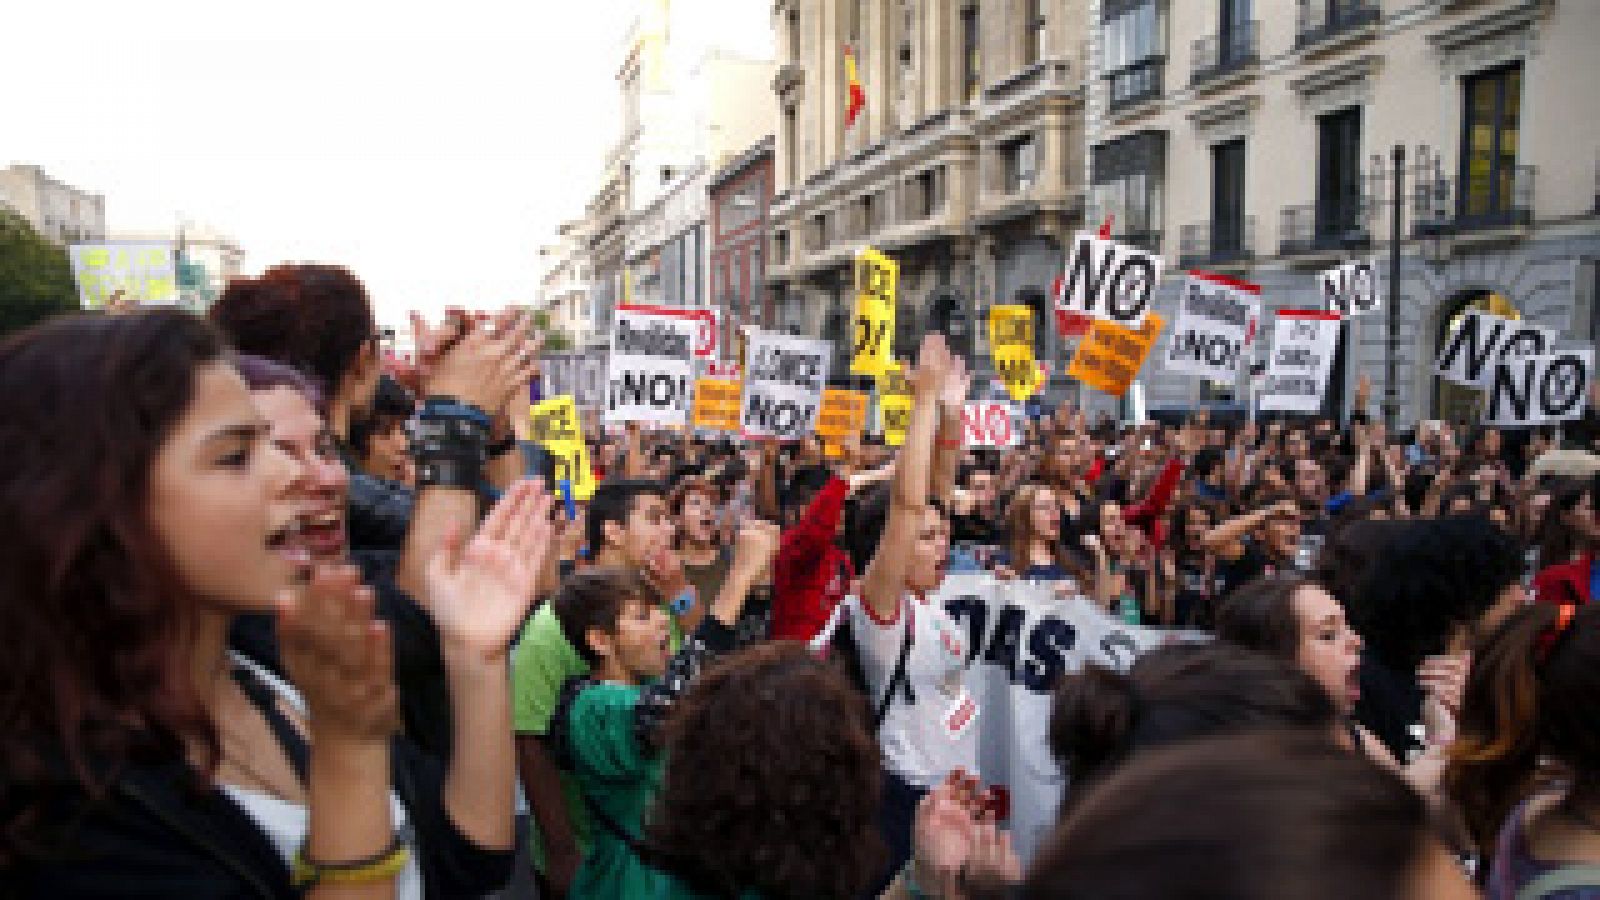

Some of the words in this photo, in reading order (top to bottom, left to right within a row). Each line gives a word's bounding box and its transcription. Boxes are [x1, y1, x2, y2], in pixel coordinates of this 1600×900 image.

[1062, 239, 1155, 320] NO
[1323, 261, 1376, 314] NO
[608, 370, 686, 410] ¡NO!
[1488, 354, 1586, 421] NO
[960, 403, 1012, 446] NO
